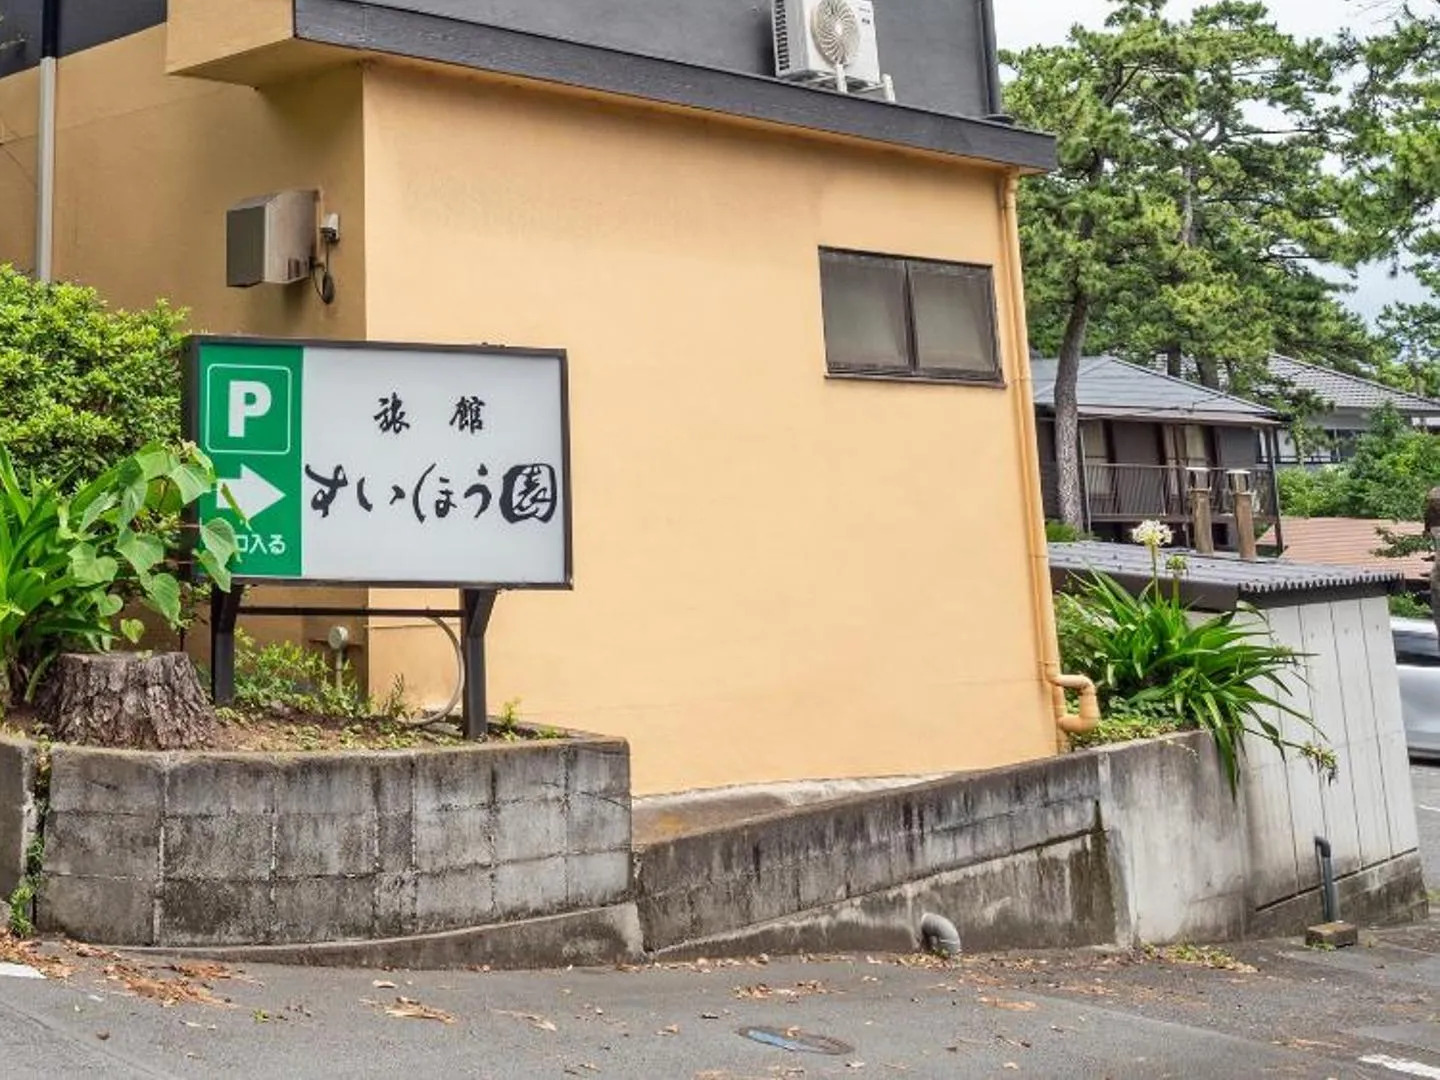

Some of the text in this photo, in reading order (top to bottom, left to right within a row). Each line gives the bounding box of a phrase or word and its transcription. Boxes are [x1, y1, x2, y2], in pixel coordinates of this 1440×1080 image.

[227, 380, 272, 438] P
[373, 392, 486, 435] 旅館
[304, 462, 558, 525] すいほう園
[235, 534, 286, 555] 口入る
